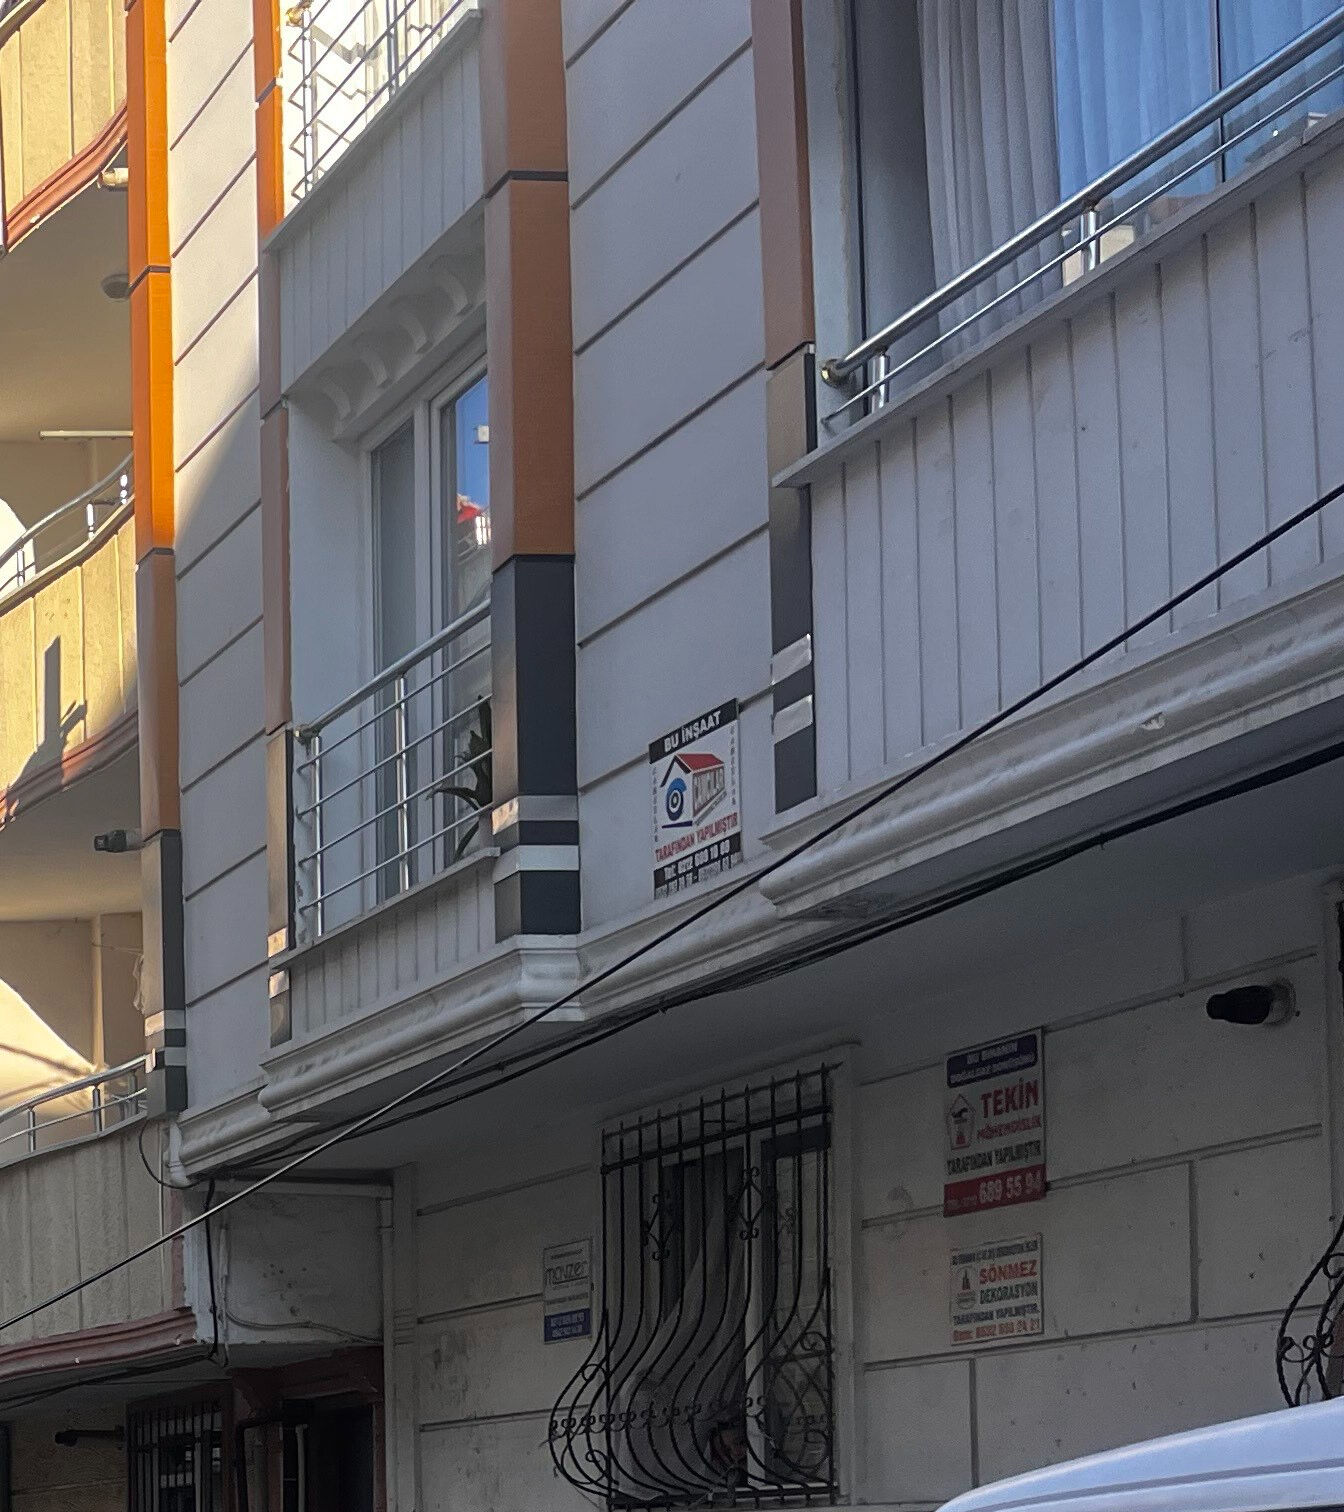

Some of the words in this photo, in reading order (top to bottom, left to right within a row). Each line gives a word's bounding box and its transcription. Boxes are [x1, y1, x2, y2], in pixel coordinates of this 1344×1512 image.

[664, 733, 679, 753] BU
[682, 711, 721, 743] İNŞAAT
[655, 832, 694, 862] TARAFINDAN
[981, 1077, 1039, 1118] TEKİN
[1006, 1175, 1022, 1199] 55
[979, 1259, 1038, 1285] SÖNMEZ
